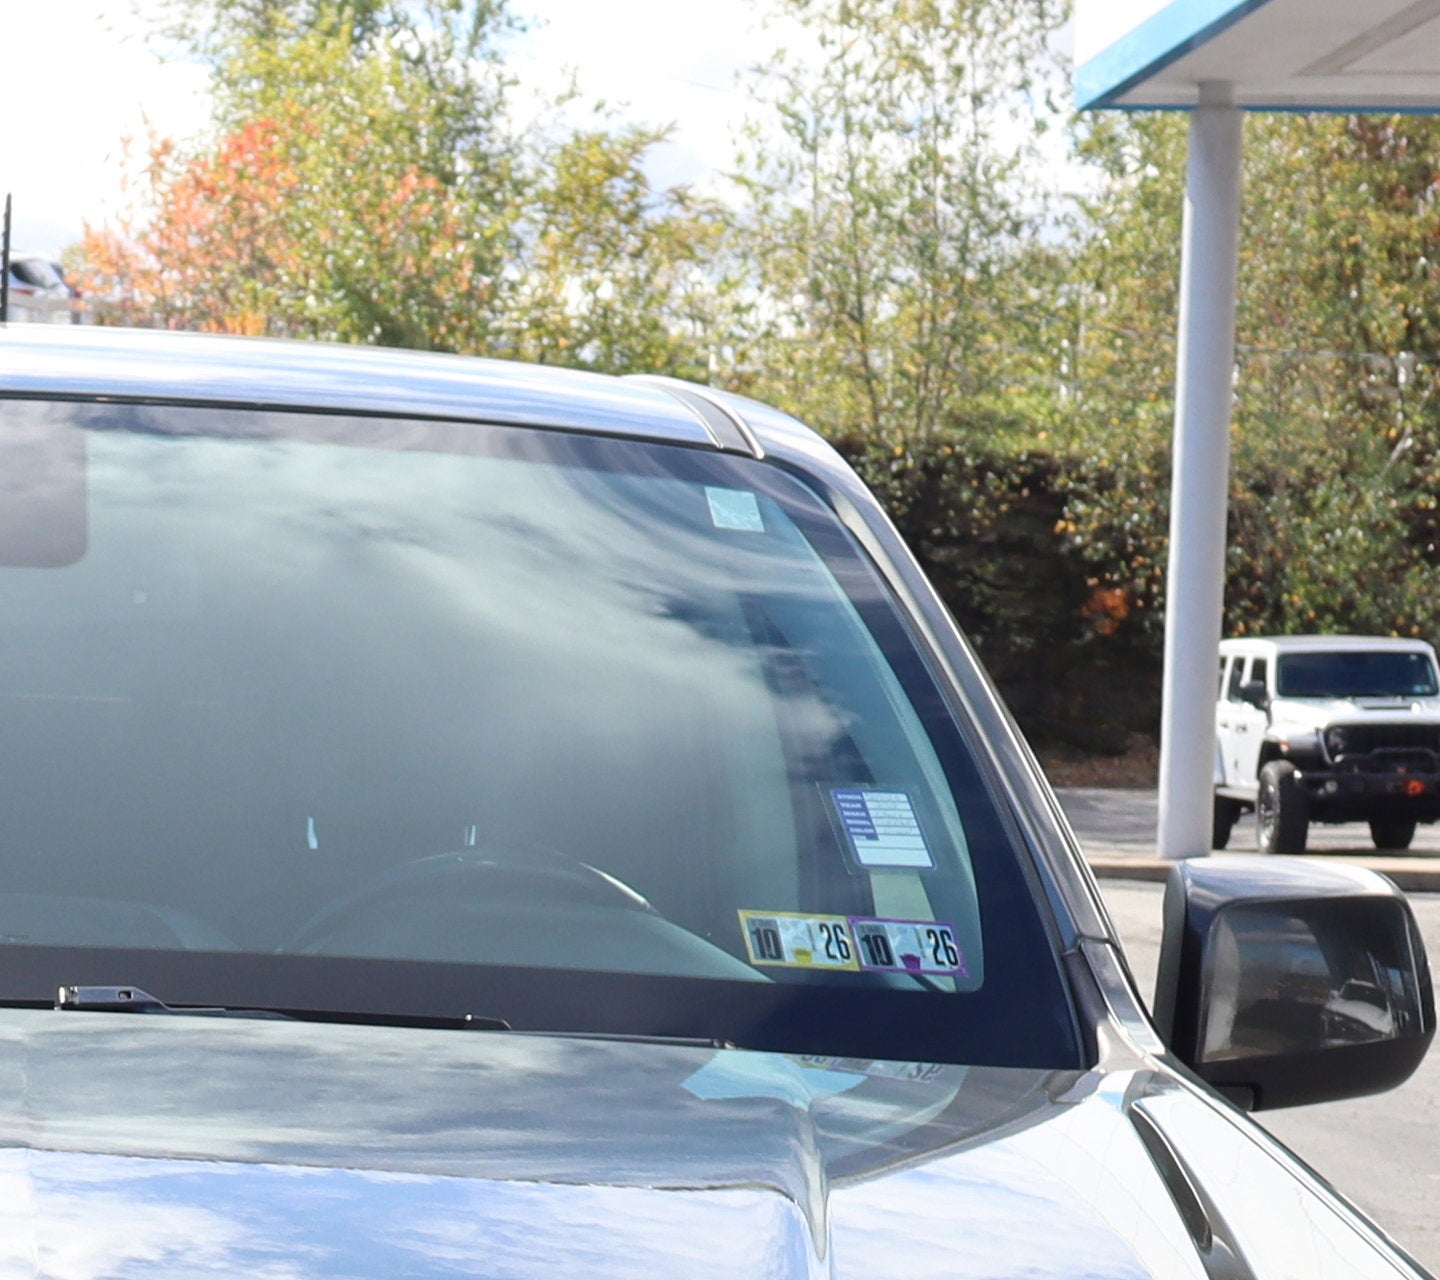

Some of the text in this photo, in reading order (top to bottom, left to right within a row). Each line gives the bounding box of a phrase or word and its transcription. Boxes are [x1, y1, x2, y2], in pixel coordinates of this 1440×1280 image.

[751, 923, 851, 961] 10 26
[862, 928, 959, 966] 10 26
